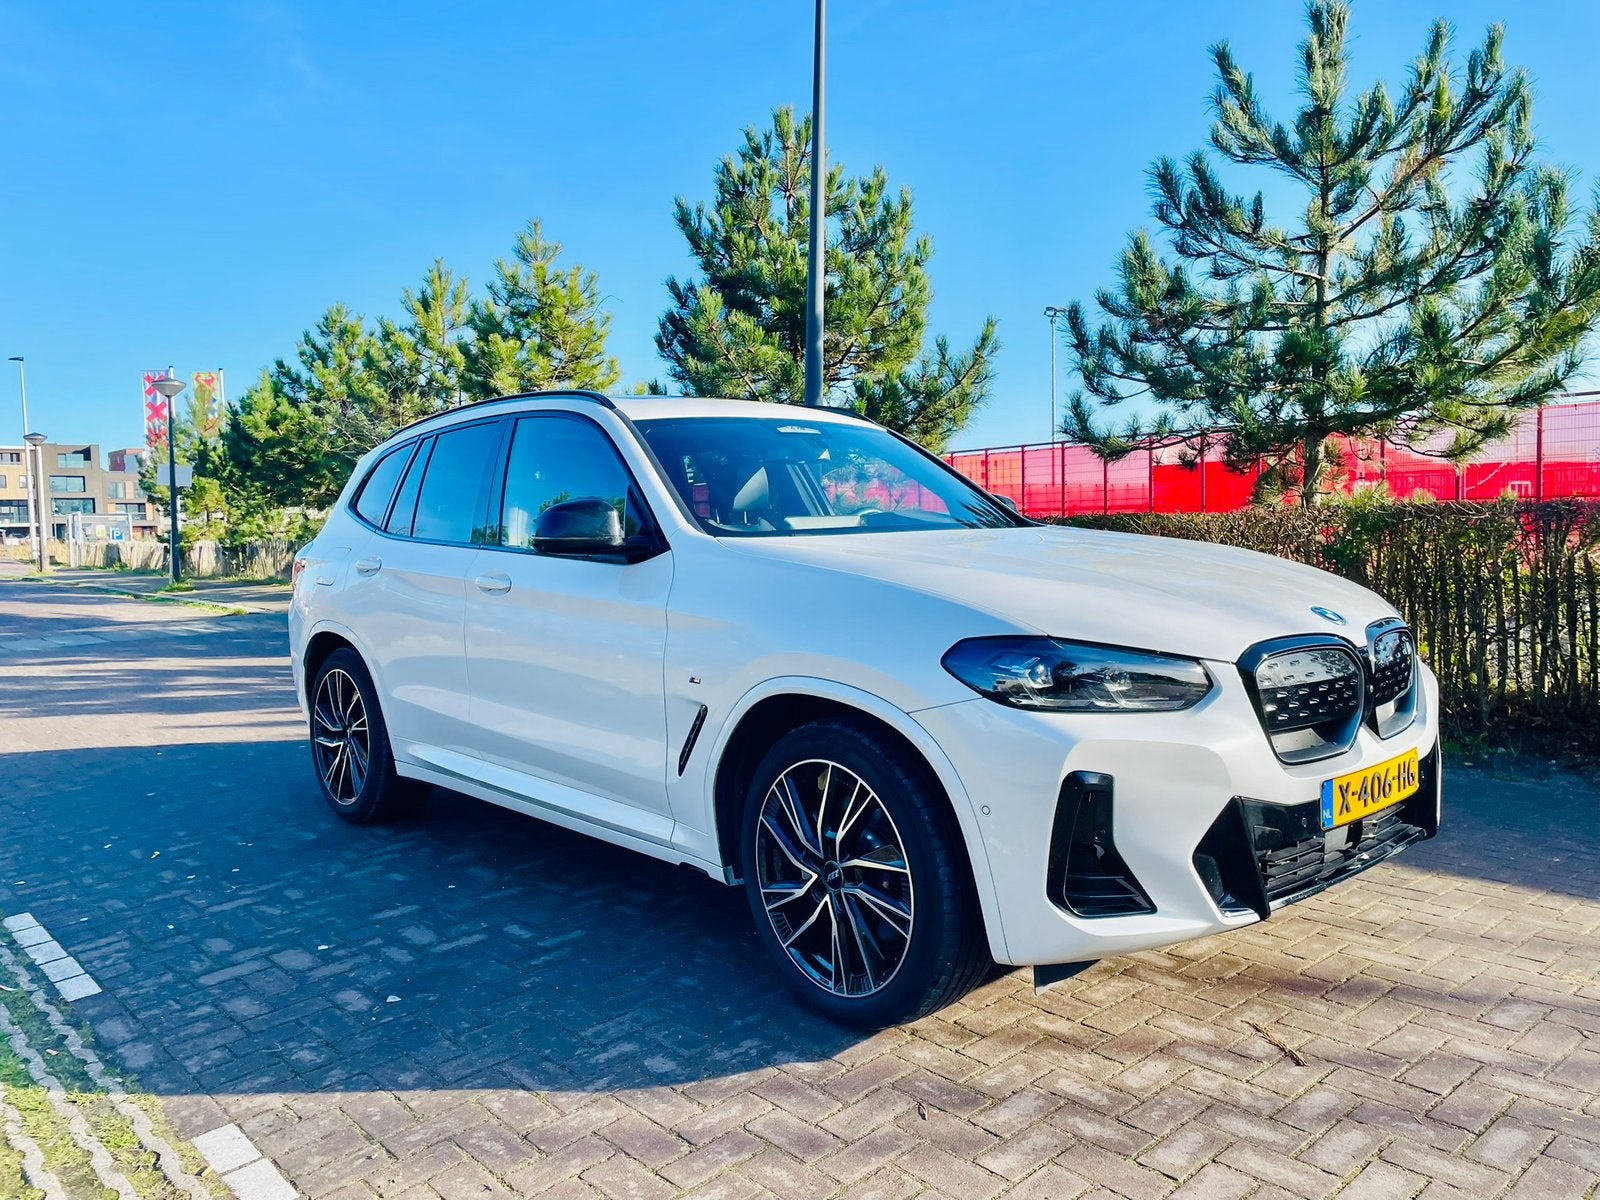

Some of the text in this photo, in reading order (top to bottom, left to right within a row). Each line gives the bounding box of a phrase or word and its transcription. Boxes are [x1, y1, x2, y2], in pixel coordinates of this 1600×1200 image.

[113, 530, 121, 539] P
[1339, 757, 1415, 816] X-406-HG
[1323, 809, 1332, 819] NL
